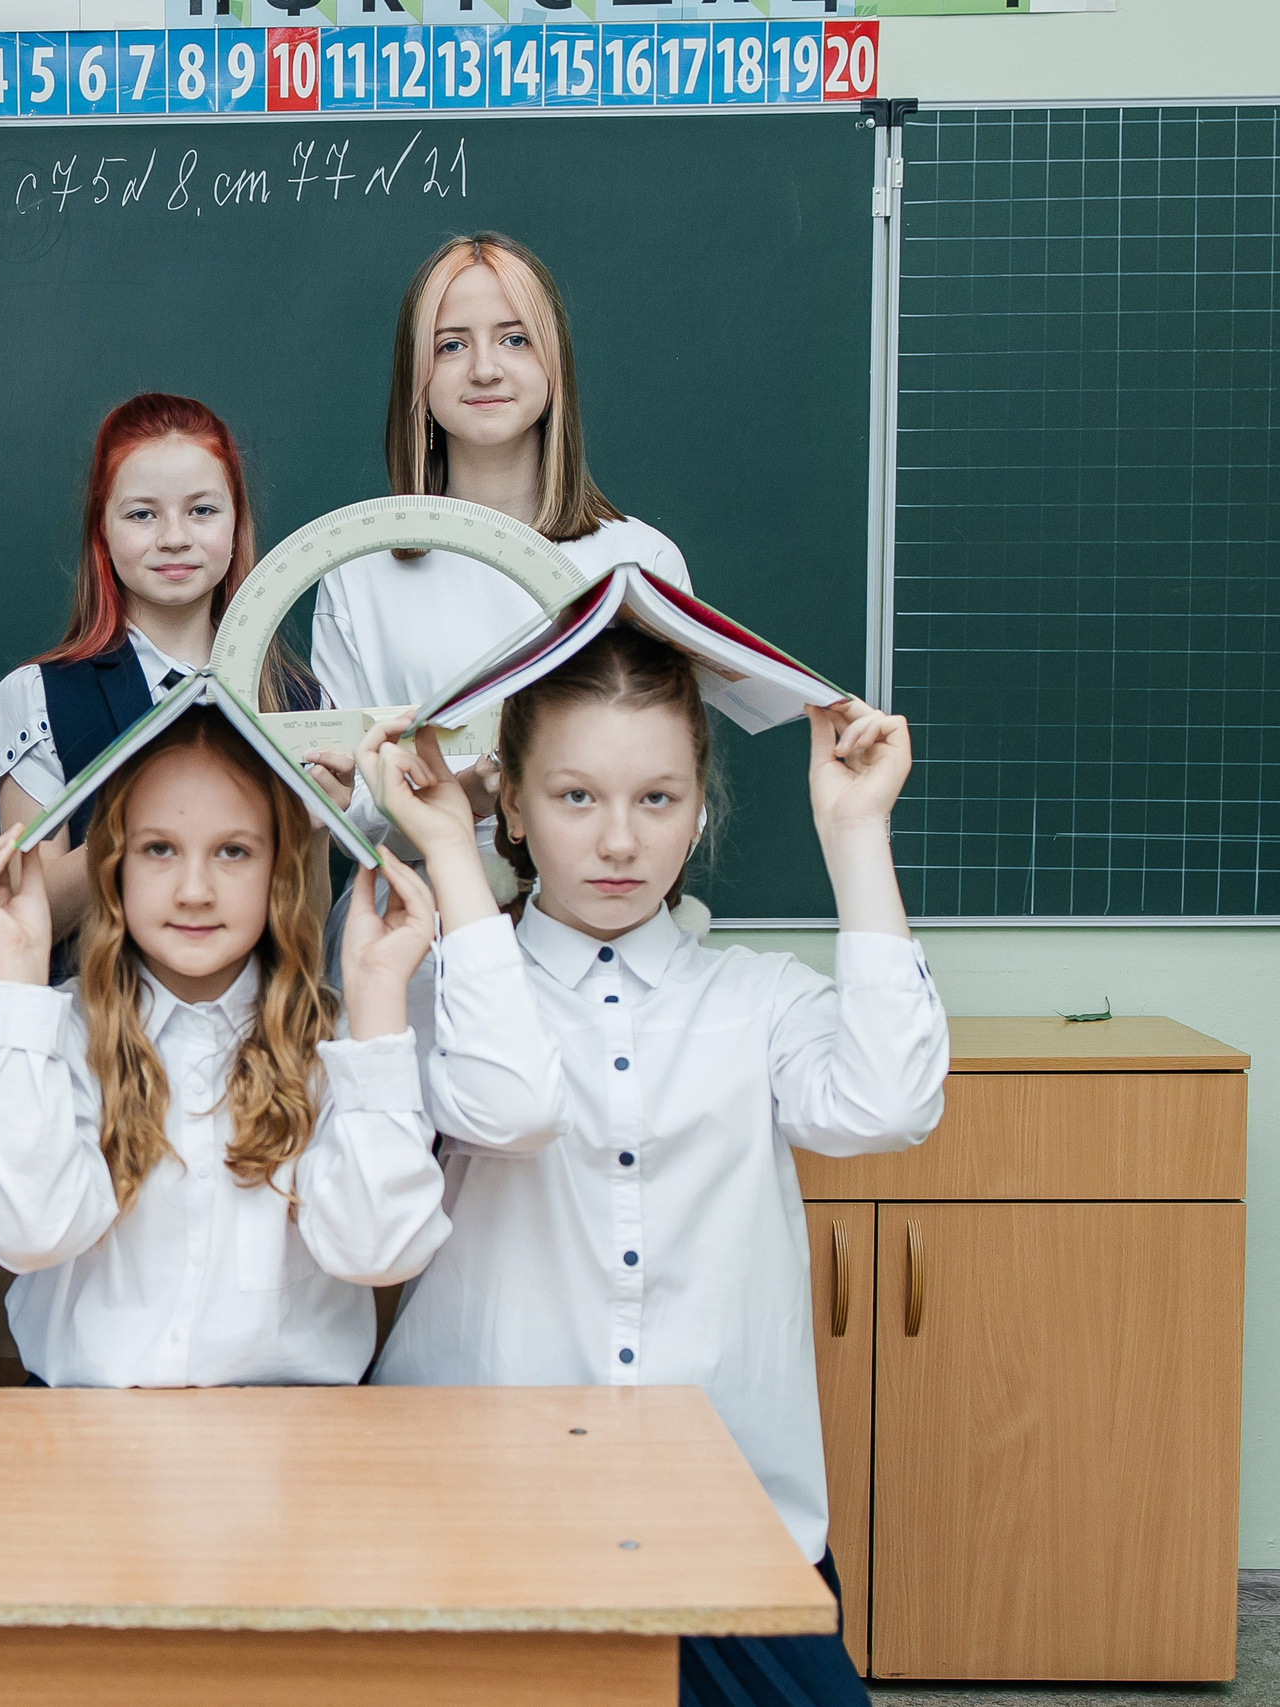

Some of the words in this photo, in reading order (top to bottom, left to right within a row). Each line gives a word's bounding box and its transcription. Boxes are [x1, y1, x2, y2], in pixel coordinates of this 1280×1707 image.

[29, 46, 56, 104] 5
[79, 45, 108, 102] 6
[128, 44, 156, 101] 7
[178, 43, 206, 101] 8
[227, 42, 256, 100] 9
[272, 41, 317, 99] 10
[326, 42, 366, 99] 11
[381, 41, 427, 98] 12
[437, 40, 482, 98] 13
[493, 40, 541, 97] 14
[550, 39, 595, 97] 15
[605, 38, 653, 96] 16
[661, 38, 708, 95] 17
[716, 37, 765, 95] 18
[772, 35, 820, 94] 19
[824, 35, 876, 93] 20
[423, 136, 468, 198] 21
[361, 517, 375, 526] 100
[395, 512, 406, 520] 90
[429, 512, 440, 520] 80
[463, 518, 474, 527] 70
